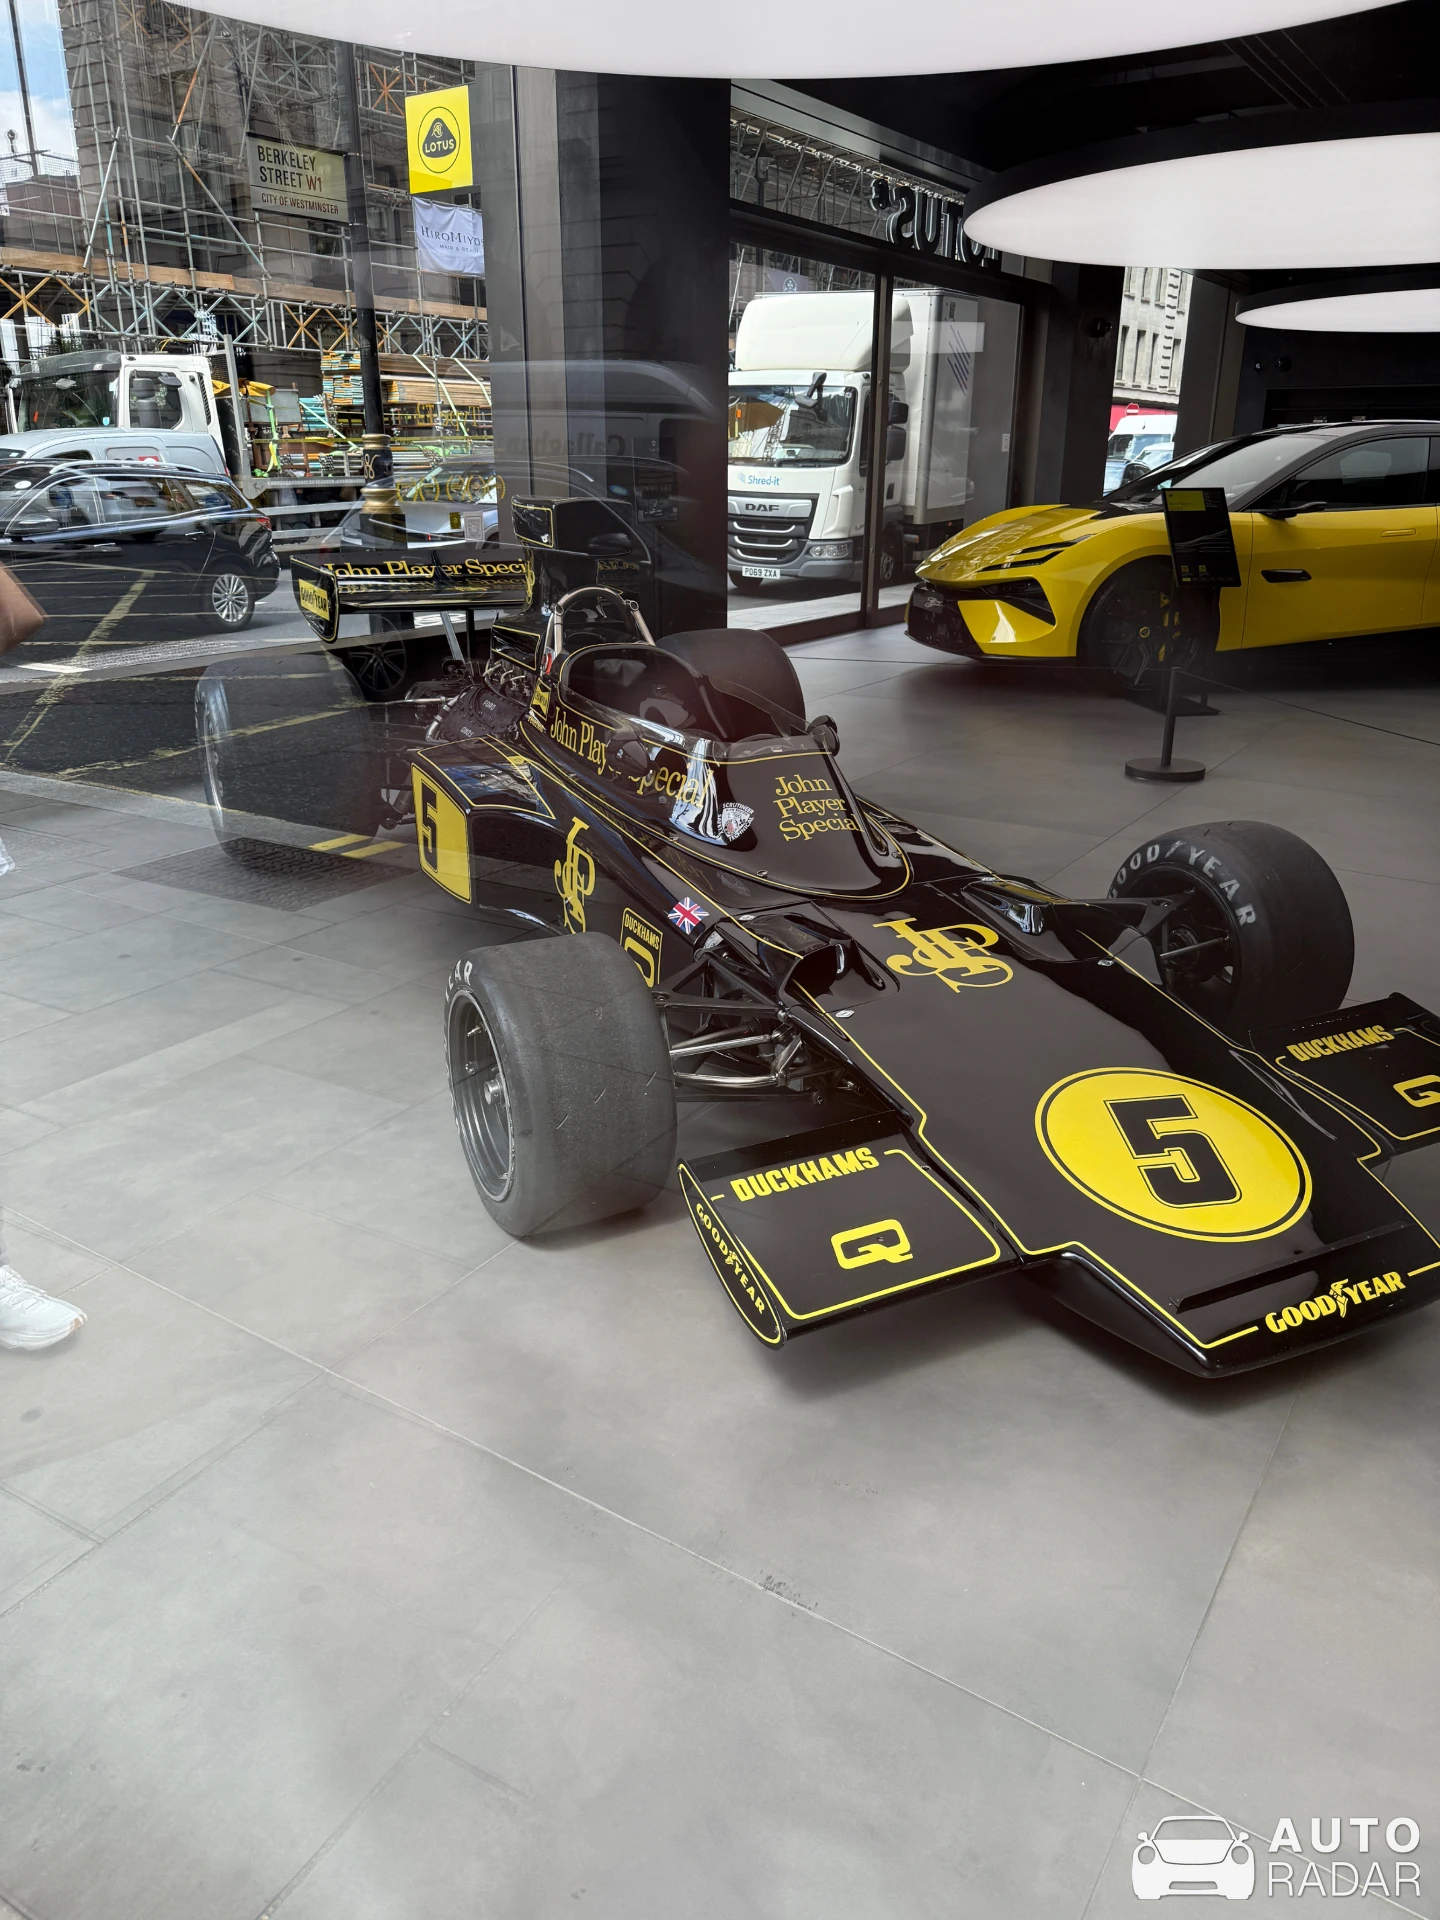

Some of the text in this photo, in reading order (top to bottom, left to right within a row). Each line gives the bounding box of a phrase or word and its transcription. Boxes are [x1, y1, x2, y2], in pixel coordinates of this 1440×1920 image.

[257, 145, 316, 171] BERKELEY
[424, 138, 454, 154] LOTUS
[259, 166, 323, 192] STREET W1
[261, 192, 339, 215] CITY OF WESTMINSTER
[747, 474, 780, 486] Shred-it
[745, 503, 780, 512] DAF
[464, 558, 526, 577] Speci
[744, 567, 778, 578] PO69 ZXA
[482, 699, 497, 711] FORD
[550, 706, 714, 808] John Play pecial
[775, 774, 832, 797] John
[773, 796, 847, 820] Player
[421, 779, 439, 874] 5
[779, 813, 865, 842] Special
[624, 913, 660, 951] DUCKHAMS
[1286, 1024, 1395, 1062] DUCKHAMS
[1103, 1093, 1243, 1209] 5
[730, 1147, 880, 1202] DUCKHAMS
[830, 1218, 914, 1270] Q
